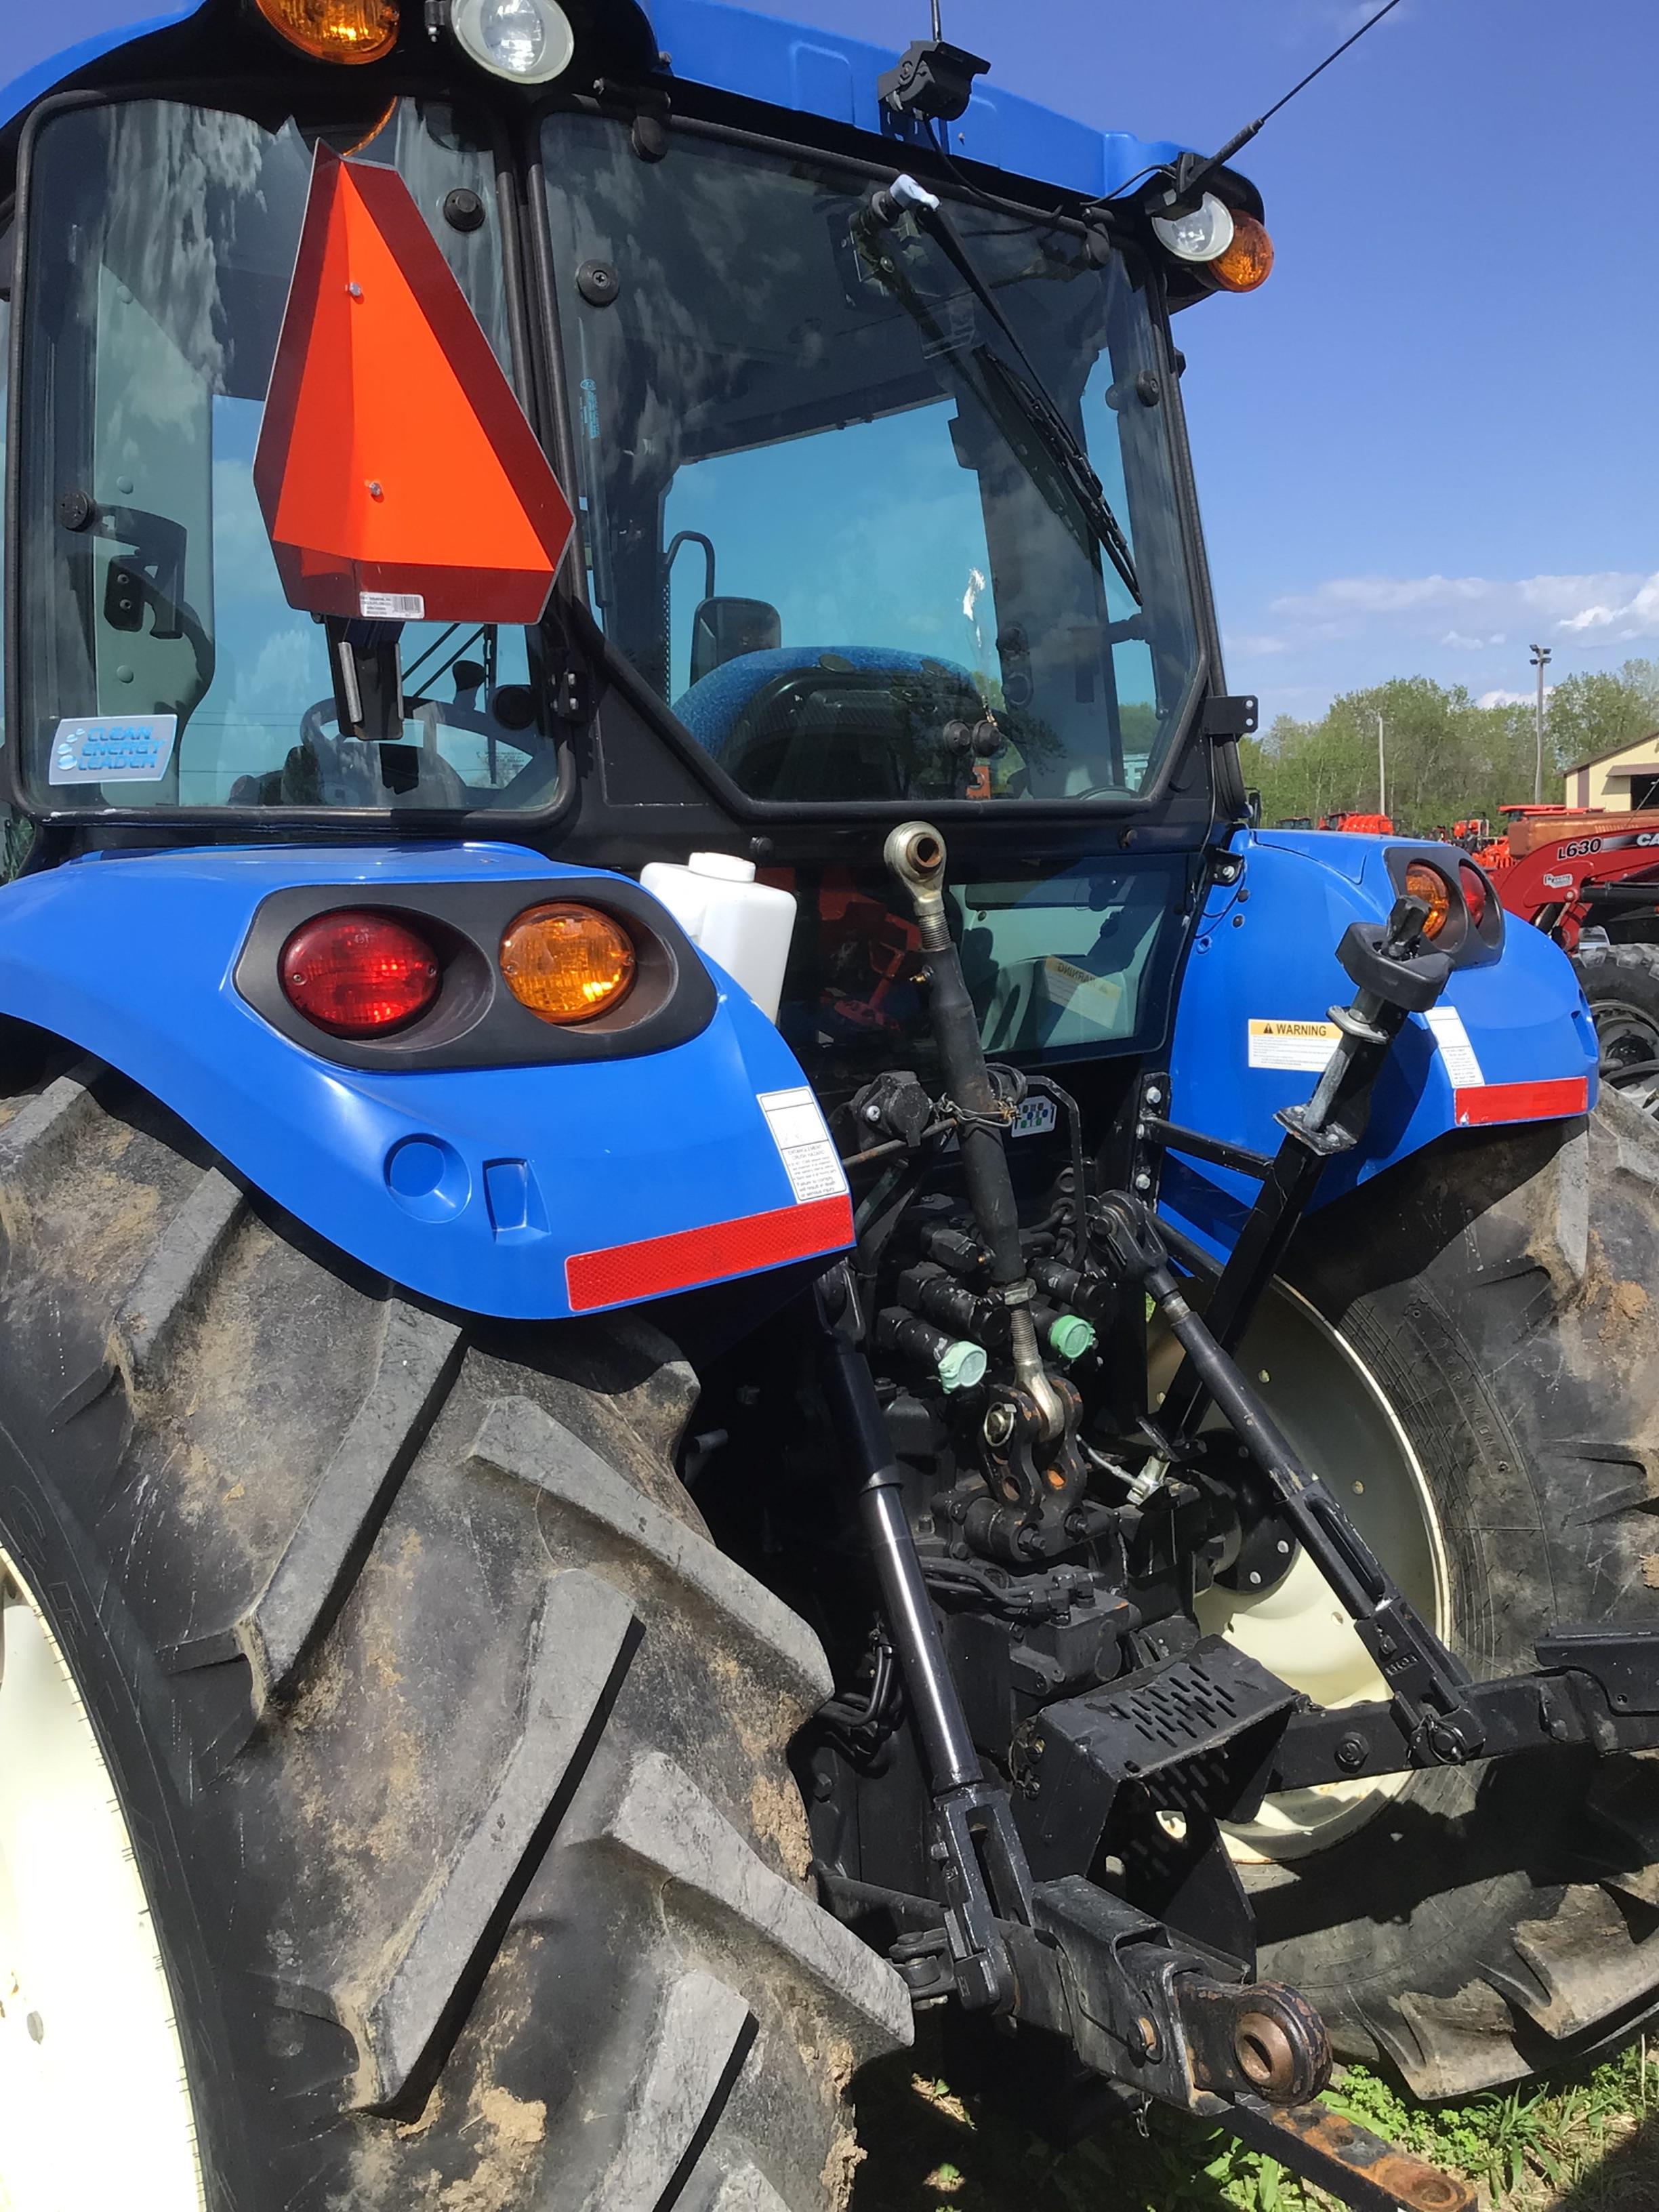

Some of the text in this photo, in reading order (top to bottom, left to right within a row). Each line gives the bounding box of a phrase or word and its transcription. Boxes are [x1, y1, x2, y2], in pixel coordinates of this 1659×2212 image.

[87, 726, 152, 741] CLEAN
[82, 739, 165, 756] ENERGY
[78, 754, 158, 771] LEADER
[1558, 838, 1601, 860] L630
[1276, 1023, 1327, 1037] WARNING
